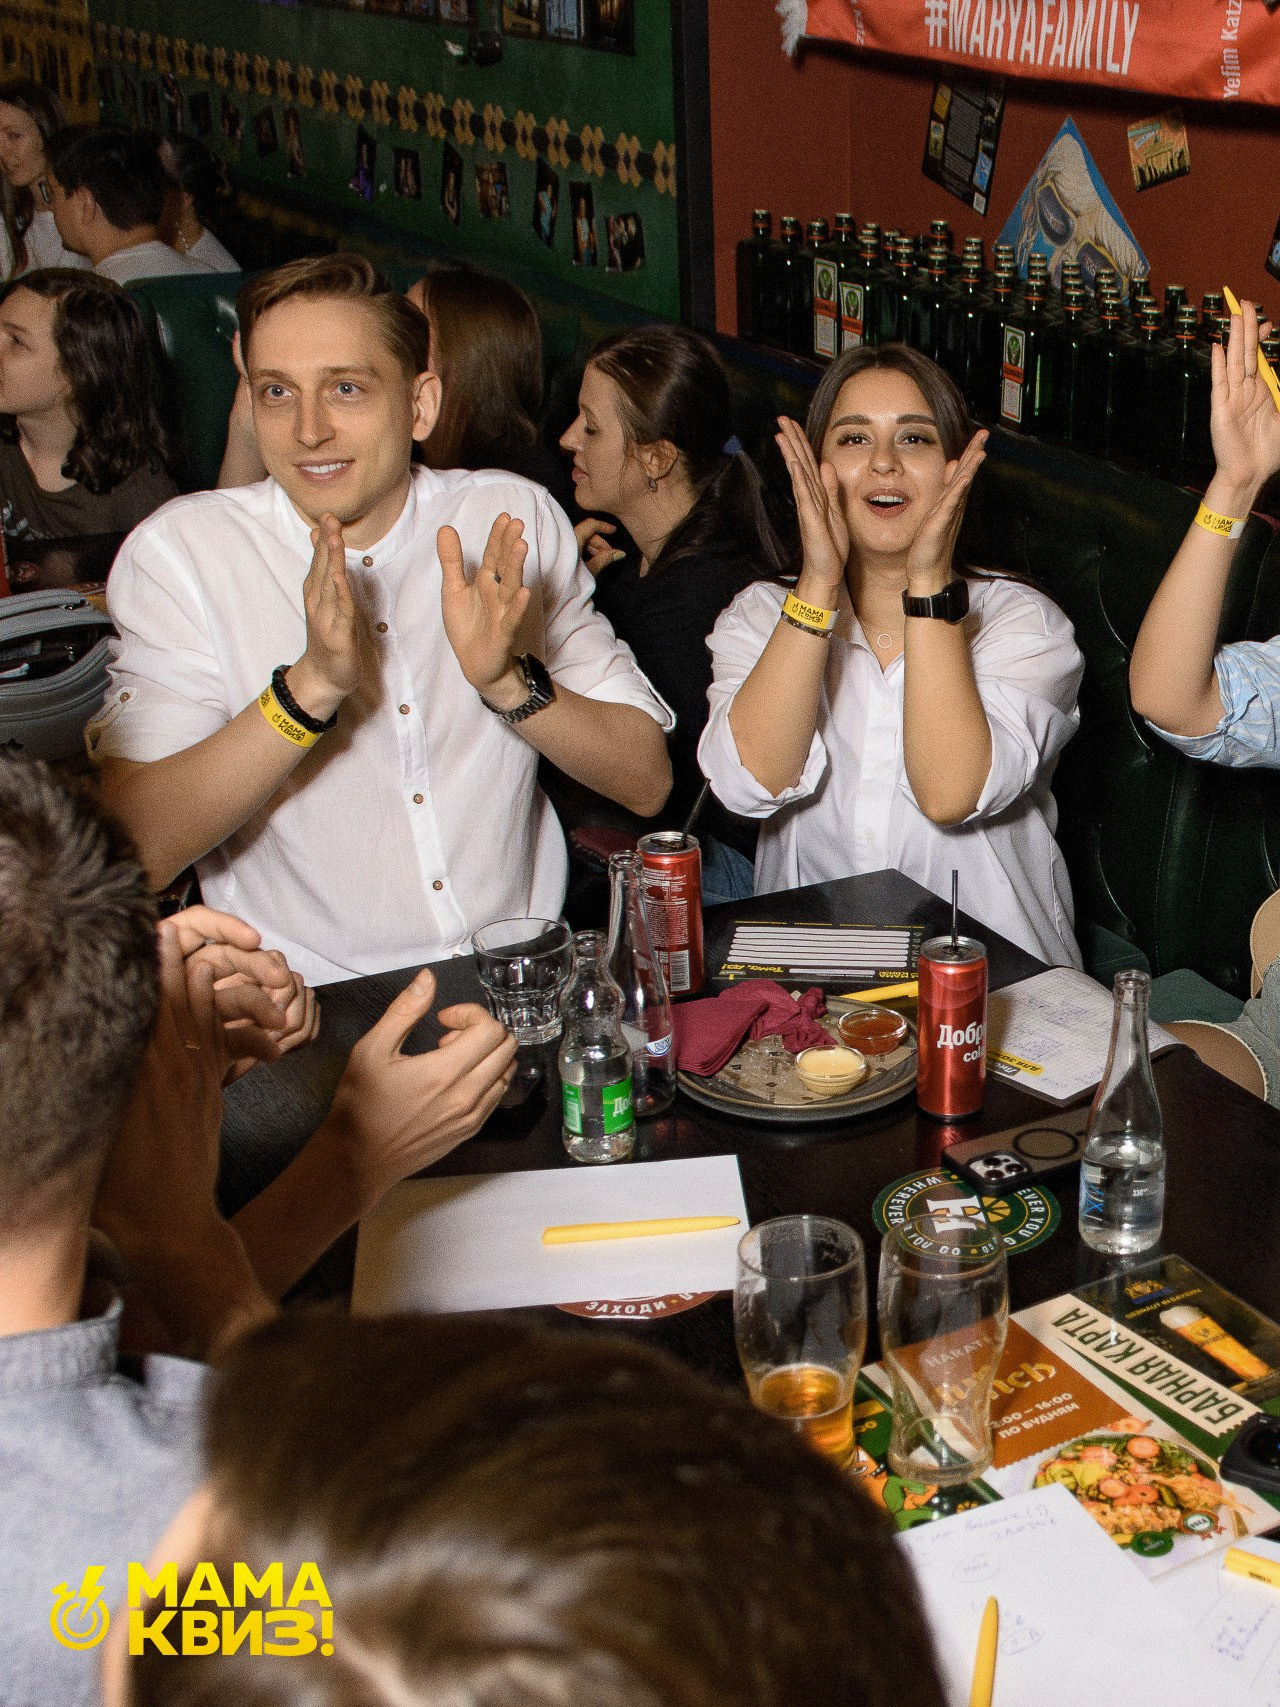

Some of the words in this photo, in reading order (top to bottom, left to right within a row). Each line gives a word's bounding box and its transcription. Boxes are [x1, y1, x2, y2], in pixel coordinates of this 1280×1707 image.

[924, 0, 1140, 76] #MARYAFAMILY
[1220, 47, 1241, 98] Yefim
[799, 604, 824, 619] МАМА
[277, 723, 304, 742] КВИЗ!
[280, 718, 306, 739] МАМА
[937, 1021, 986, 1049] Добр
[963, 1046, 985, 1063] col
[887, 1176, 943, 1225] WHEREVER
[1018, 1187, 1044, 1214] EVER
[585, 1300, 667, 1315] ЗАХОДИ
[1051, 1307, 1145, 1364] КАРТА
[1035, 1392, 1073, 1411] 16:00
[1125, 1354, 1244, 1425] БАРНАЯ
[1021, 1402, 1080, 1430] БУДНЯМ
